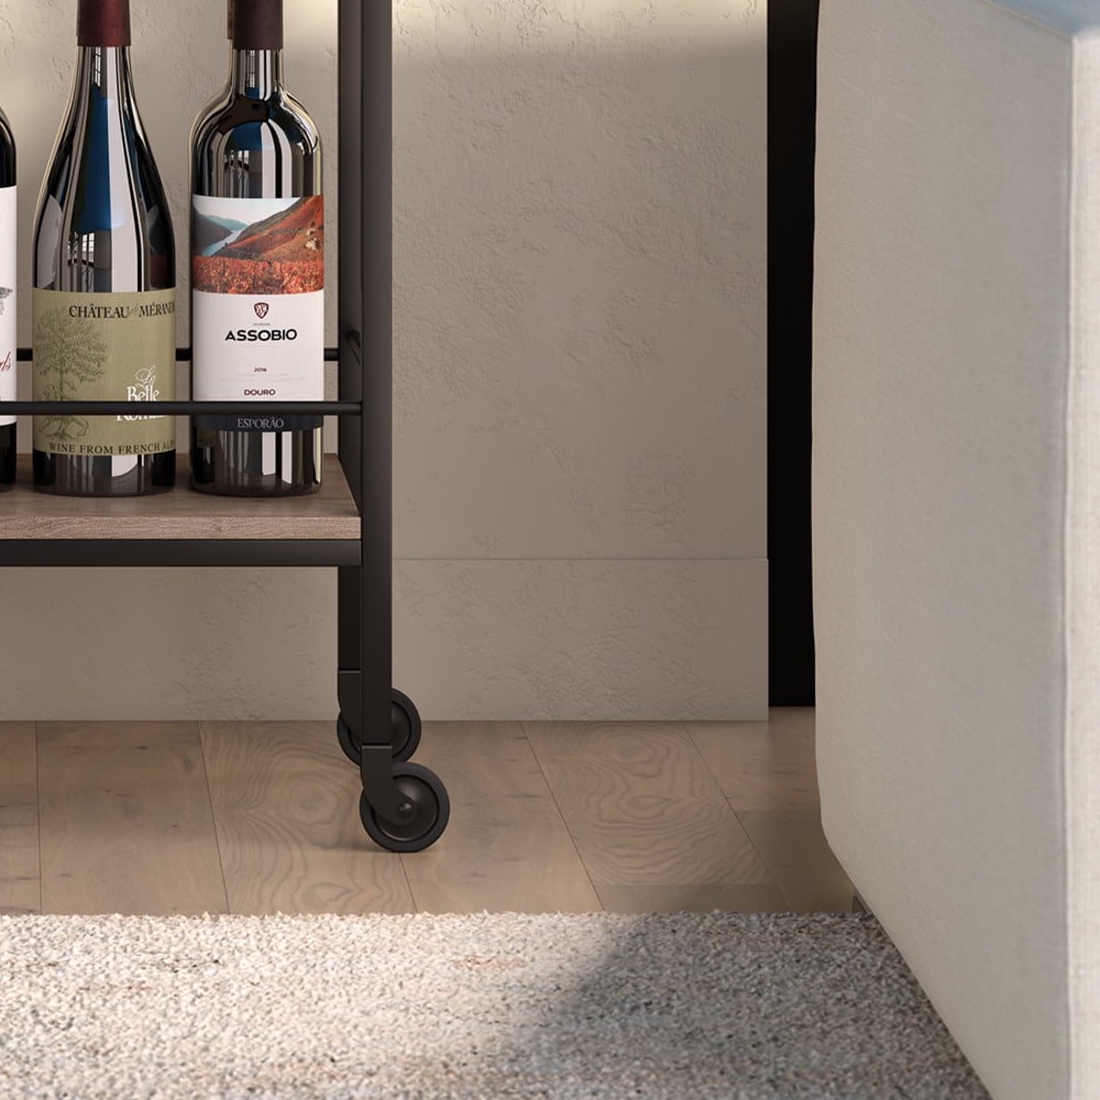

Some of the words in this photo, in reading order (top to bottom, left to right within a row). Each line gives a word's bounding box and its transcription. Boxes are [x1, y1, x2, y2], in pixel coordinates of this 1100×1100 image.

[68, 302, 130, 319] CHÂTEAU
[225, 328, 298, 341] ASSOBIO
[126, 385, 160, 402] Belle
[243, 388, 276, 396] DOURO
[237, 416, 285, 429] ESPORÃO
[48, 441, 76, 453] WINE
[79, 444, 114, 455] FROM
[118, 442, 160, 455] FRENCH
